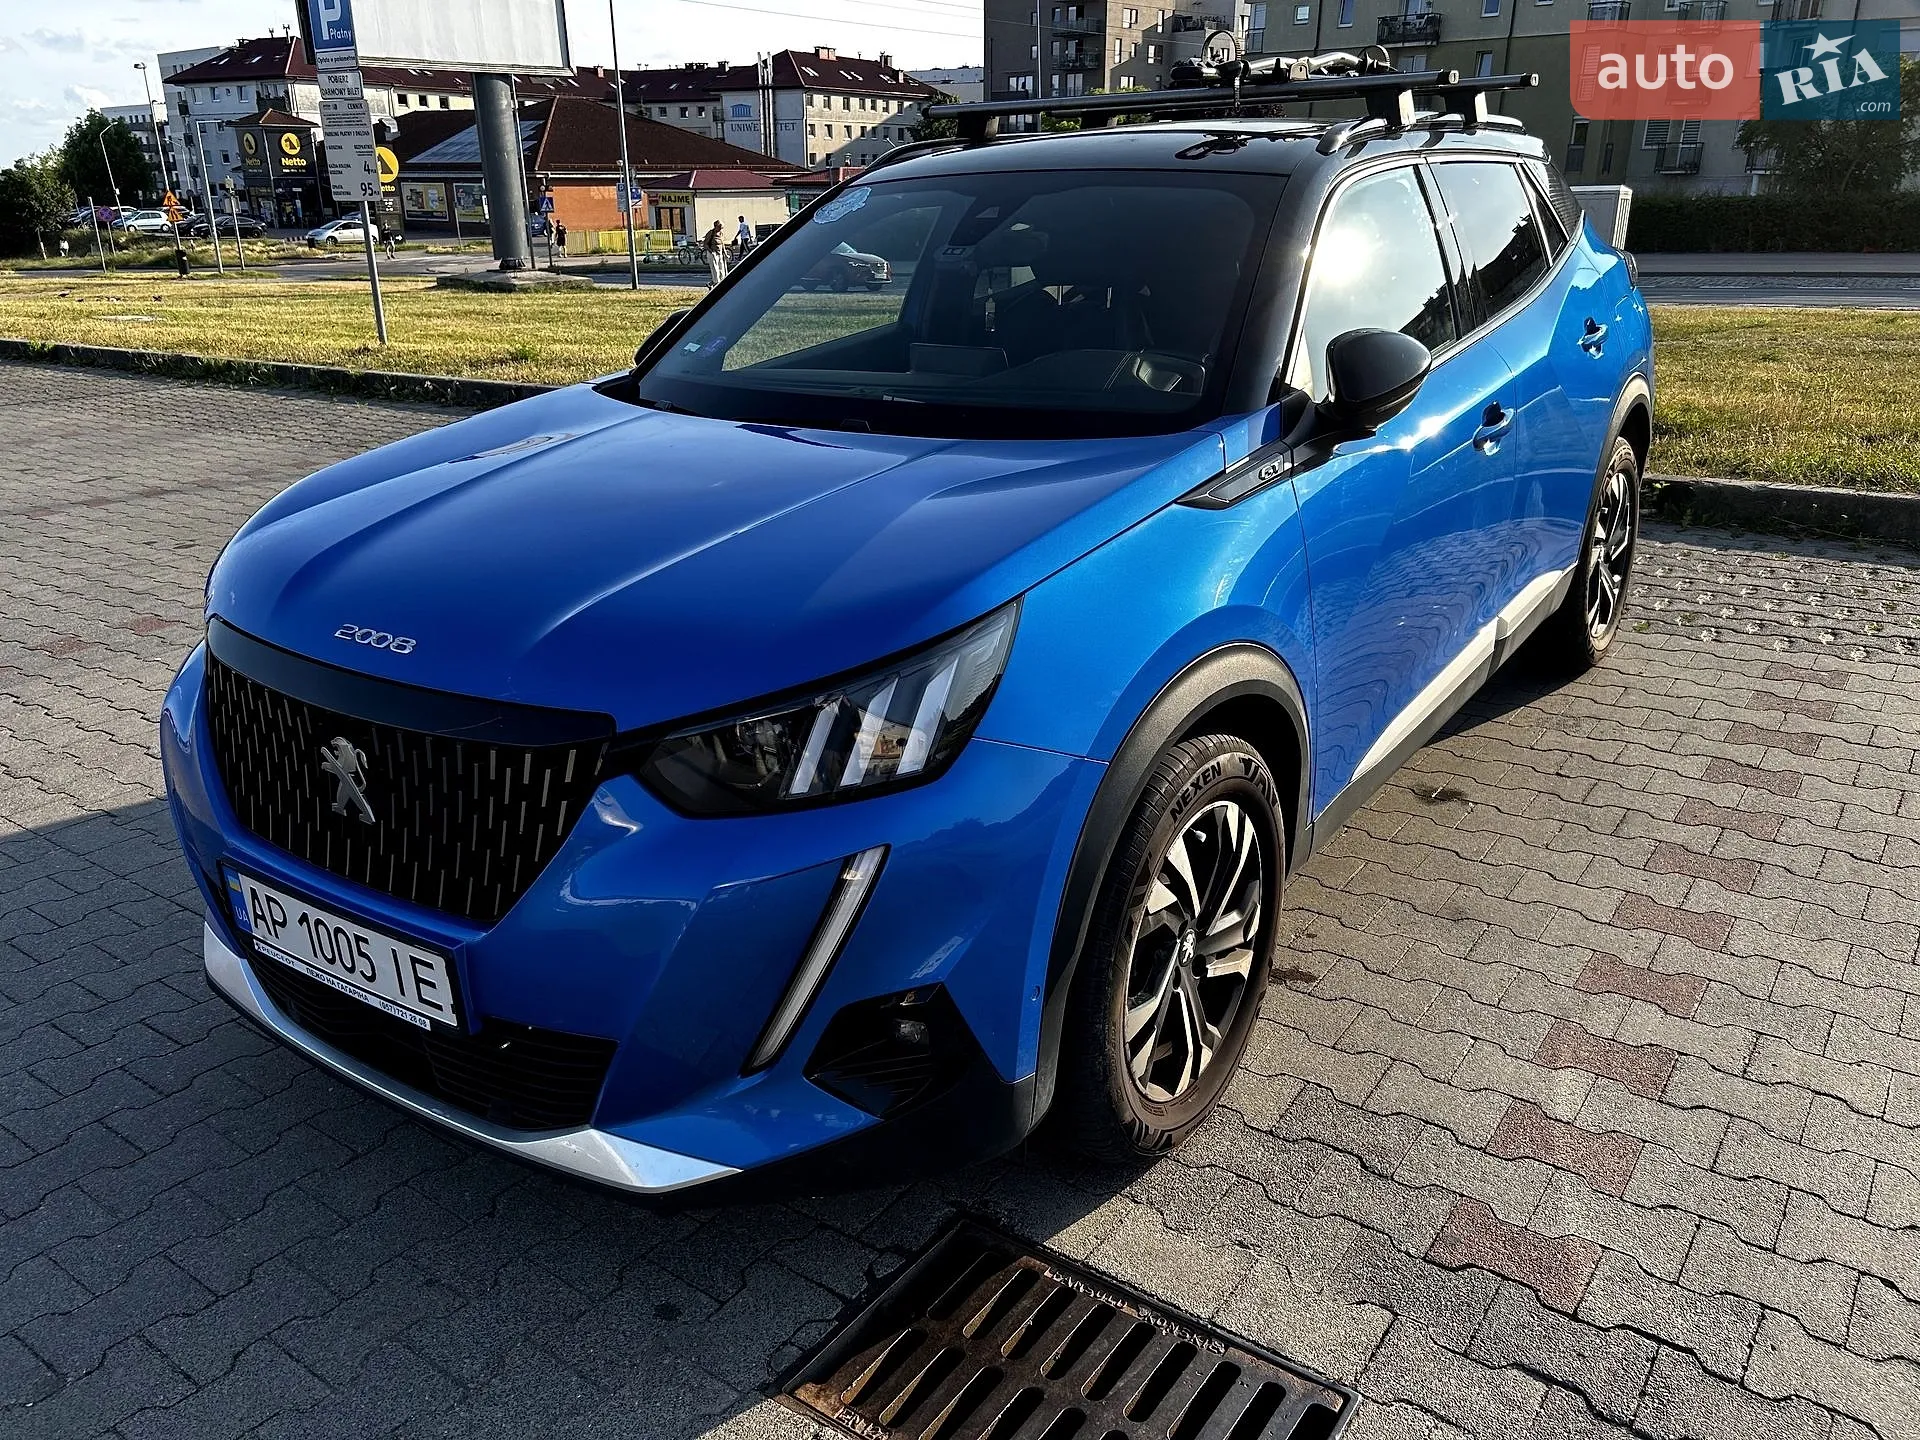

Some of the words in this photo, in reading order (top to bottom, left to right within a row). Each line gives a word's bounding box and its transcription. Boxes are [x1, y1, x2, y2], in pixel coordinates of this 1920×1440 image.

[327, 75, 349, 83] POBIERZ
[347, 87, 360, 96] BILET
[281, 157, 307, 166] Netto
[363, 160, 371, 175] 4
[360, 182, 374, 197] 95
[334, 623, 417, 654] 2008
[1169, 761, 1222, 823] NEXEN
[235, 905, 250, 924] UA
[250, 885, 288, 940] AP
[298, 911, 377, 983] 1005
[390, 946, 444, 1012] IE
